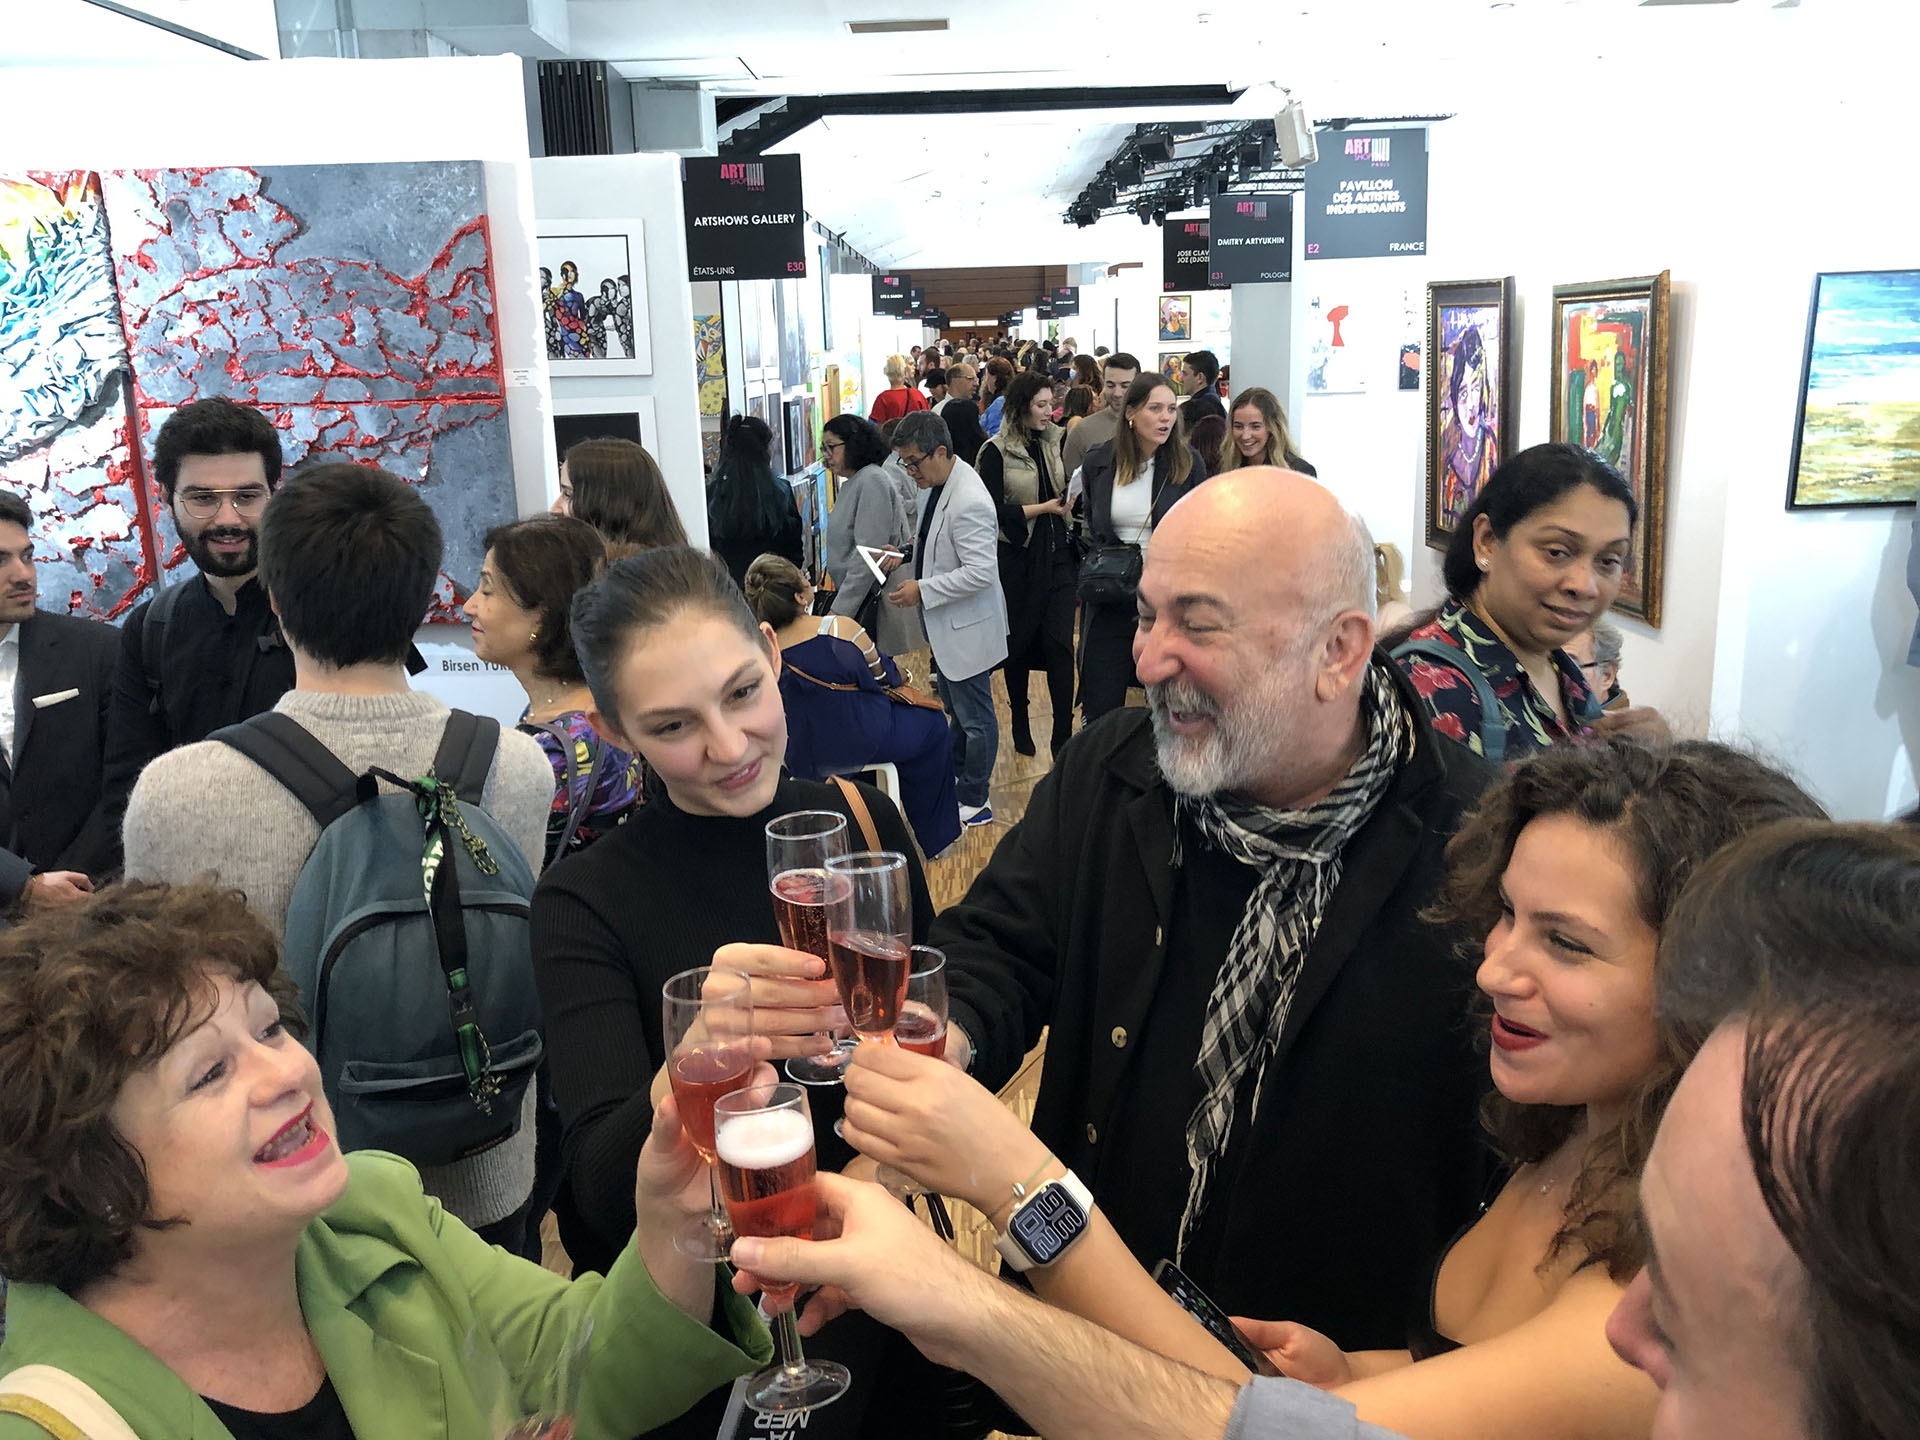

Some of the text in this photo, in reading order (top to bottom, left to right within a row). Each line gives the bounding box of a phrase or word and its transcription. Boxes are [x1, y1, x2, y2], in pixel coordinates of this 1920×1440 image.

[1344, 138, 1371, 154] ART
[720, 163, 745, 179] ART
[1339, 179, 1393, 191] PAVILLON
[1332, 190, 1400, 203] DES ARTISTES
[1236, 201, 1254, 213] ART
[1326, 201, 1406, 215] INDÉPENDANTS
[694, 213, 796, 227] ARTSHOWS GALLERY
[1184, 223, 1199, 233] ART
[1217, 236, 1285, 246] DMITRY ARTYUKHIN
[1389, 241, 1424, 251] FRANCE
[1307, 243, 1320, 254] E2
[693, 266, 735, 276] ÉTATS-UNIS
[786, 261, 805, 272] E30
[1260, 271, 1290, 279] POLOGNE
[442, 659, 479, 671] Birsen
